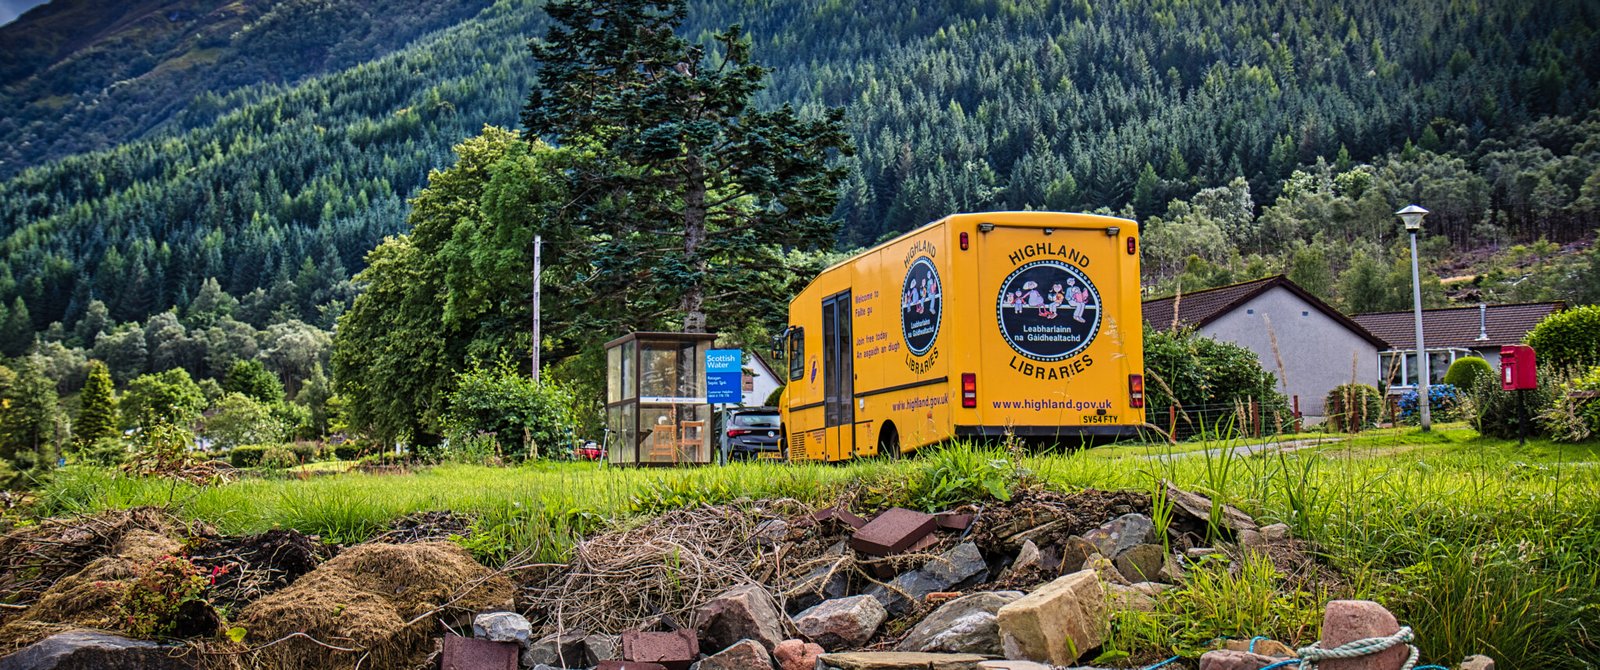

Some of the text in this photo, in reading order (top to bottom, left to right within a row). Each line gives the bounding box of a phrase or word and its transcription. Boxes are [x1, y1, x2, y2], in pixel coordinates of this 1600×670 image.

[904, 240, 936, 268] HIGHLAND
[1008, 242, 1090, 268] HIGHLAND
[855, 290, 879, 304] Welcome to
[867, 307, 873, 316] gu
[1023, 325, 1072, 333] Leabharlainn
[856, 331, 888, 346] Join free today
[905, 347, 939, 375] LIBRARIES
[1009, 354, 1094, 380] LIBRARIES
[892, 393, 949, 412] www.highland.gov.uk
[992, 399, 1112, 411] www.highland.gov.uk
[1083, 415, 1118, 423] SV54 FTY
